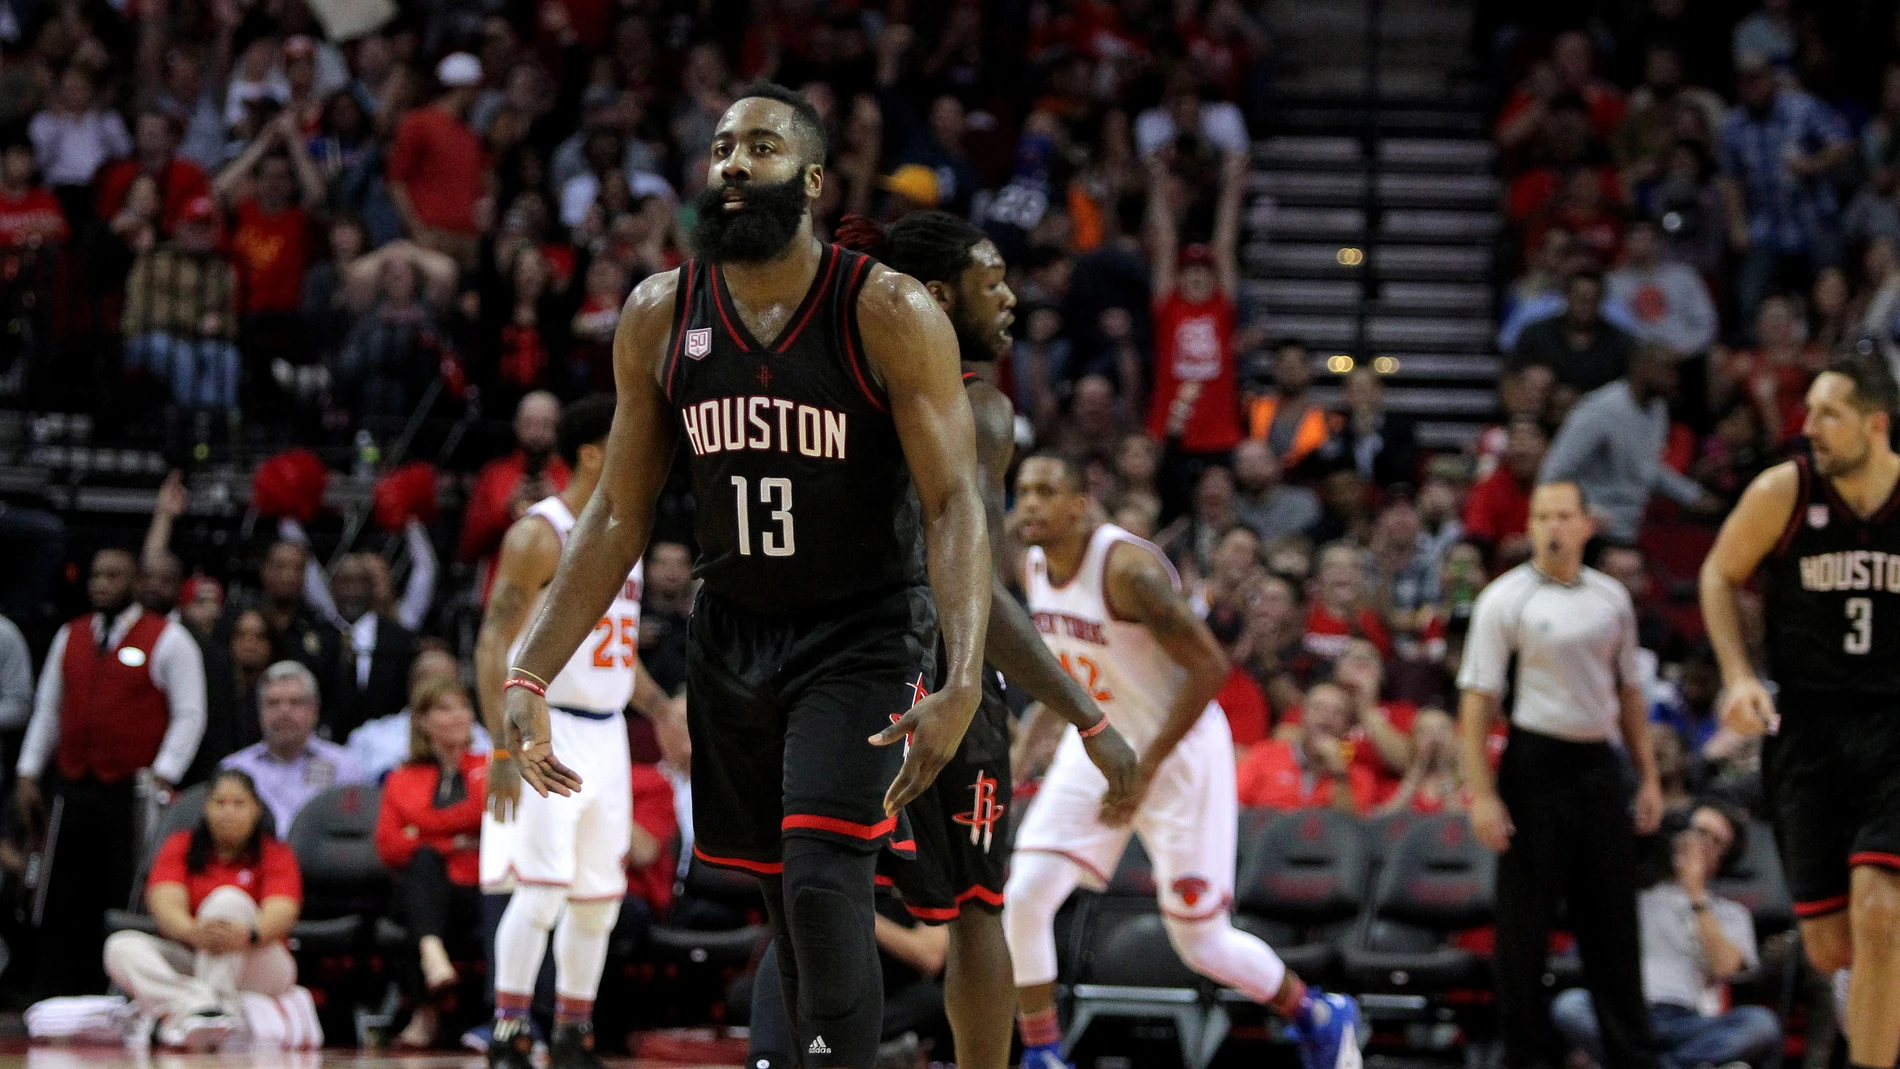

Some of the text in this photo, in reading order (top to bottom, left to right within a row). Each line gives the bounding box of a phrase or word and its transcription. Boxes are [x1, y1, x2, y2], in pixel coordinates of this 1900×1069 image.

[690, 333, 706, 347] 50
[682, 396, 847, 460] HOUSTON
[731, 475, 796, 557] 13
[1800, 550, 1900, 594] HOUSTO
[593, 617, 637, 667] 25
[1844, 597, 1873, 655] 3
